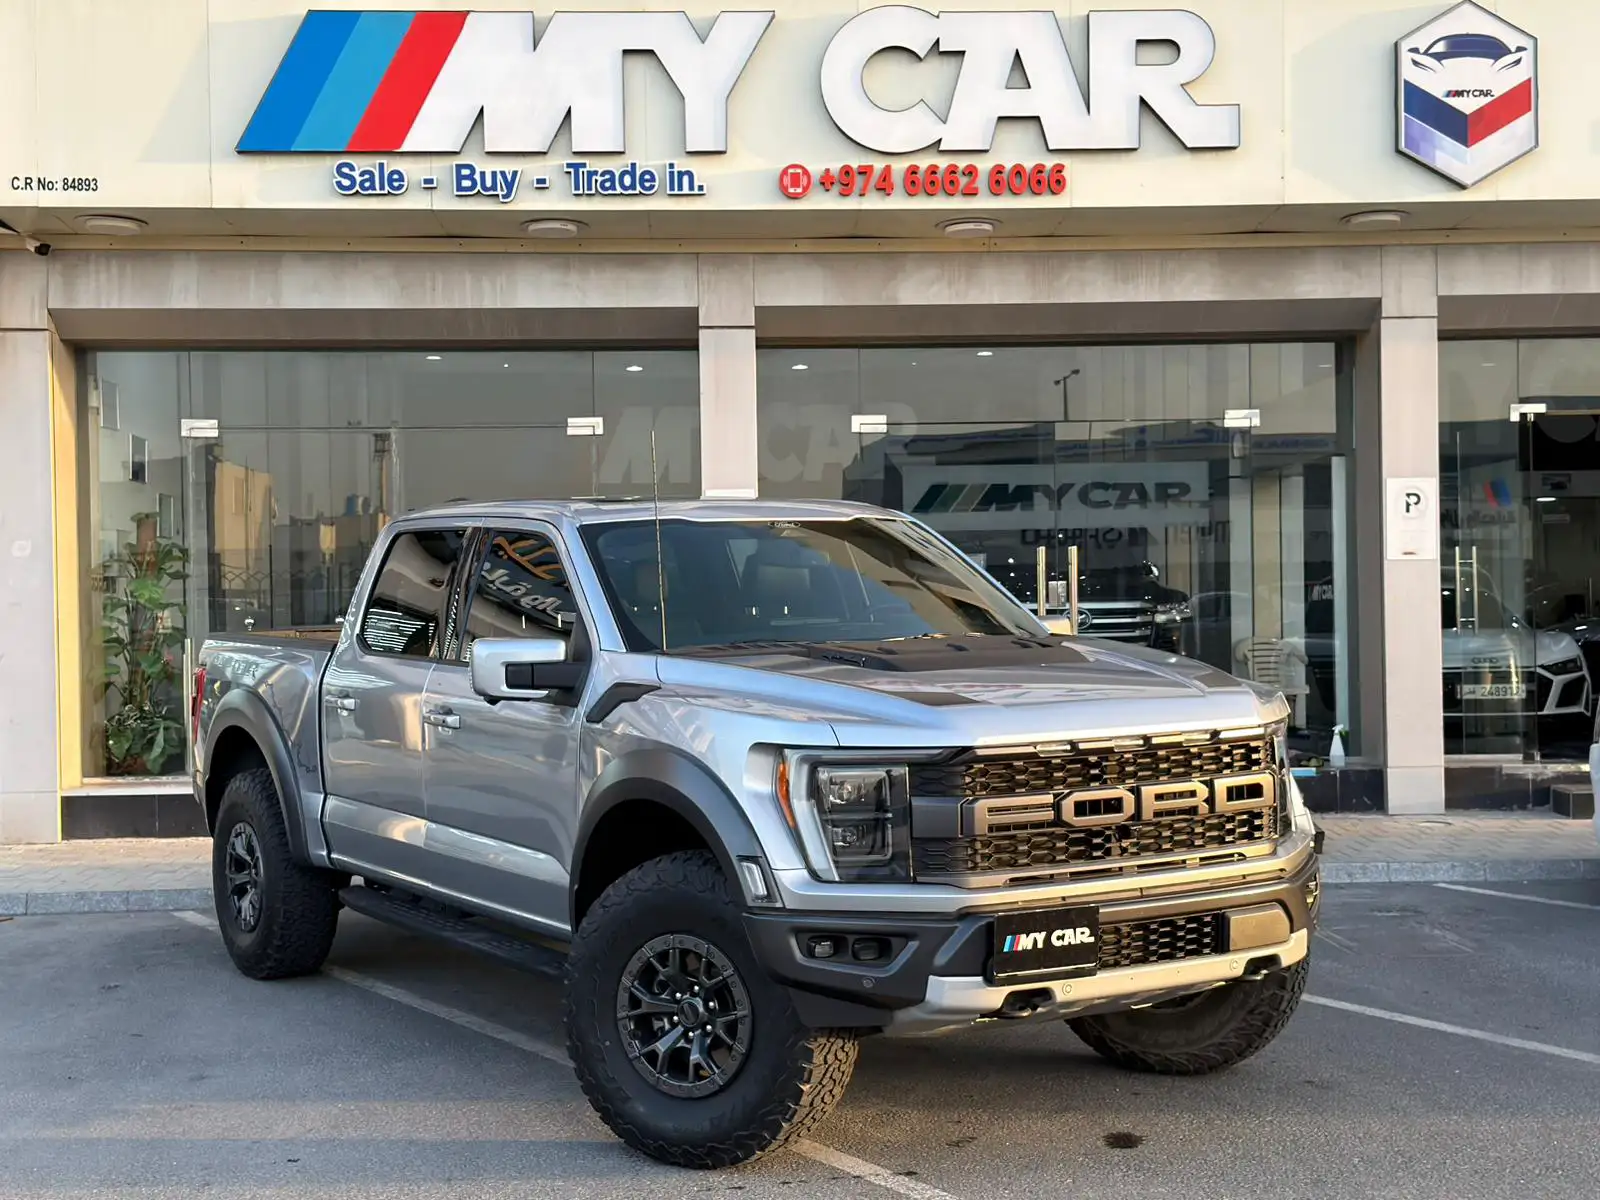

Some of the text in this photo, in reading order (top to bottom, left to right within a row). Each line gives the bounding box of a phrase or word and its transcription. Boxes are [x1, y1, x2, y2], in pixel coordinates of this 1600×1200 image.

[399, 5, 1241, 153] MY CAR
[11, 176, 98, 191] C.R No: 84893
[334, 161, 408, 196] Sale
[453, 161, 522, 203] Buy
[564, 161, 659, 196] Trade
[665, 162, 706, 196] in.
[819, 162, 1067, 196] +974 6662 6066
[962, 771, 1276, 838] FORD
[1019, 926, 1095, 952] MY CAR
